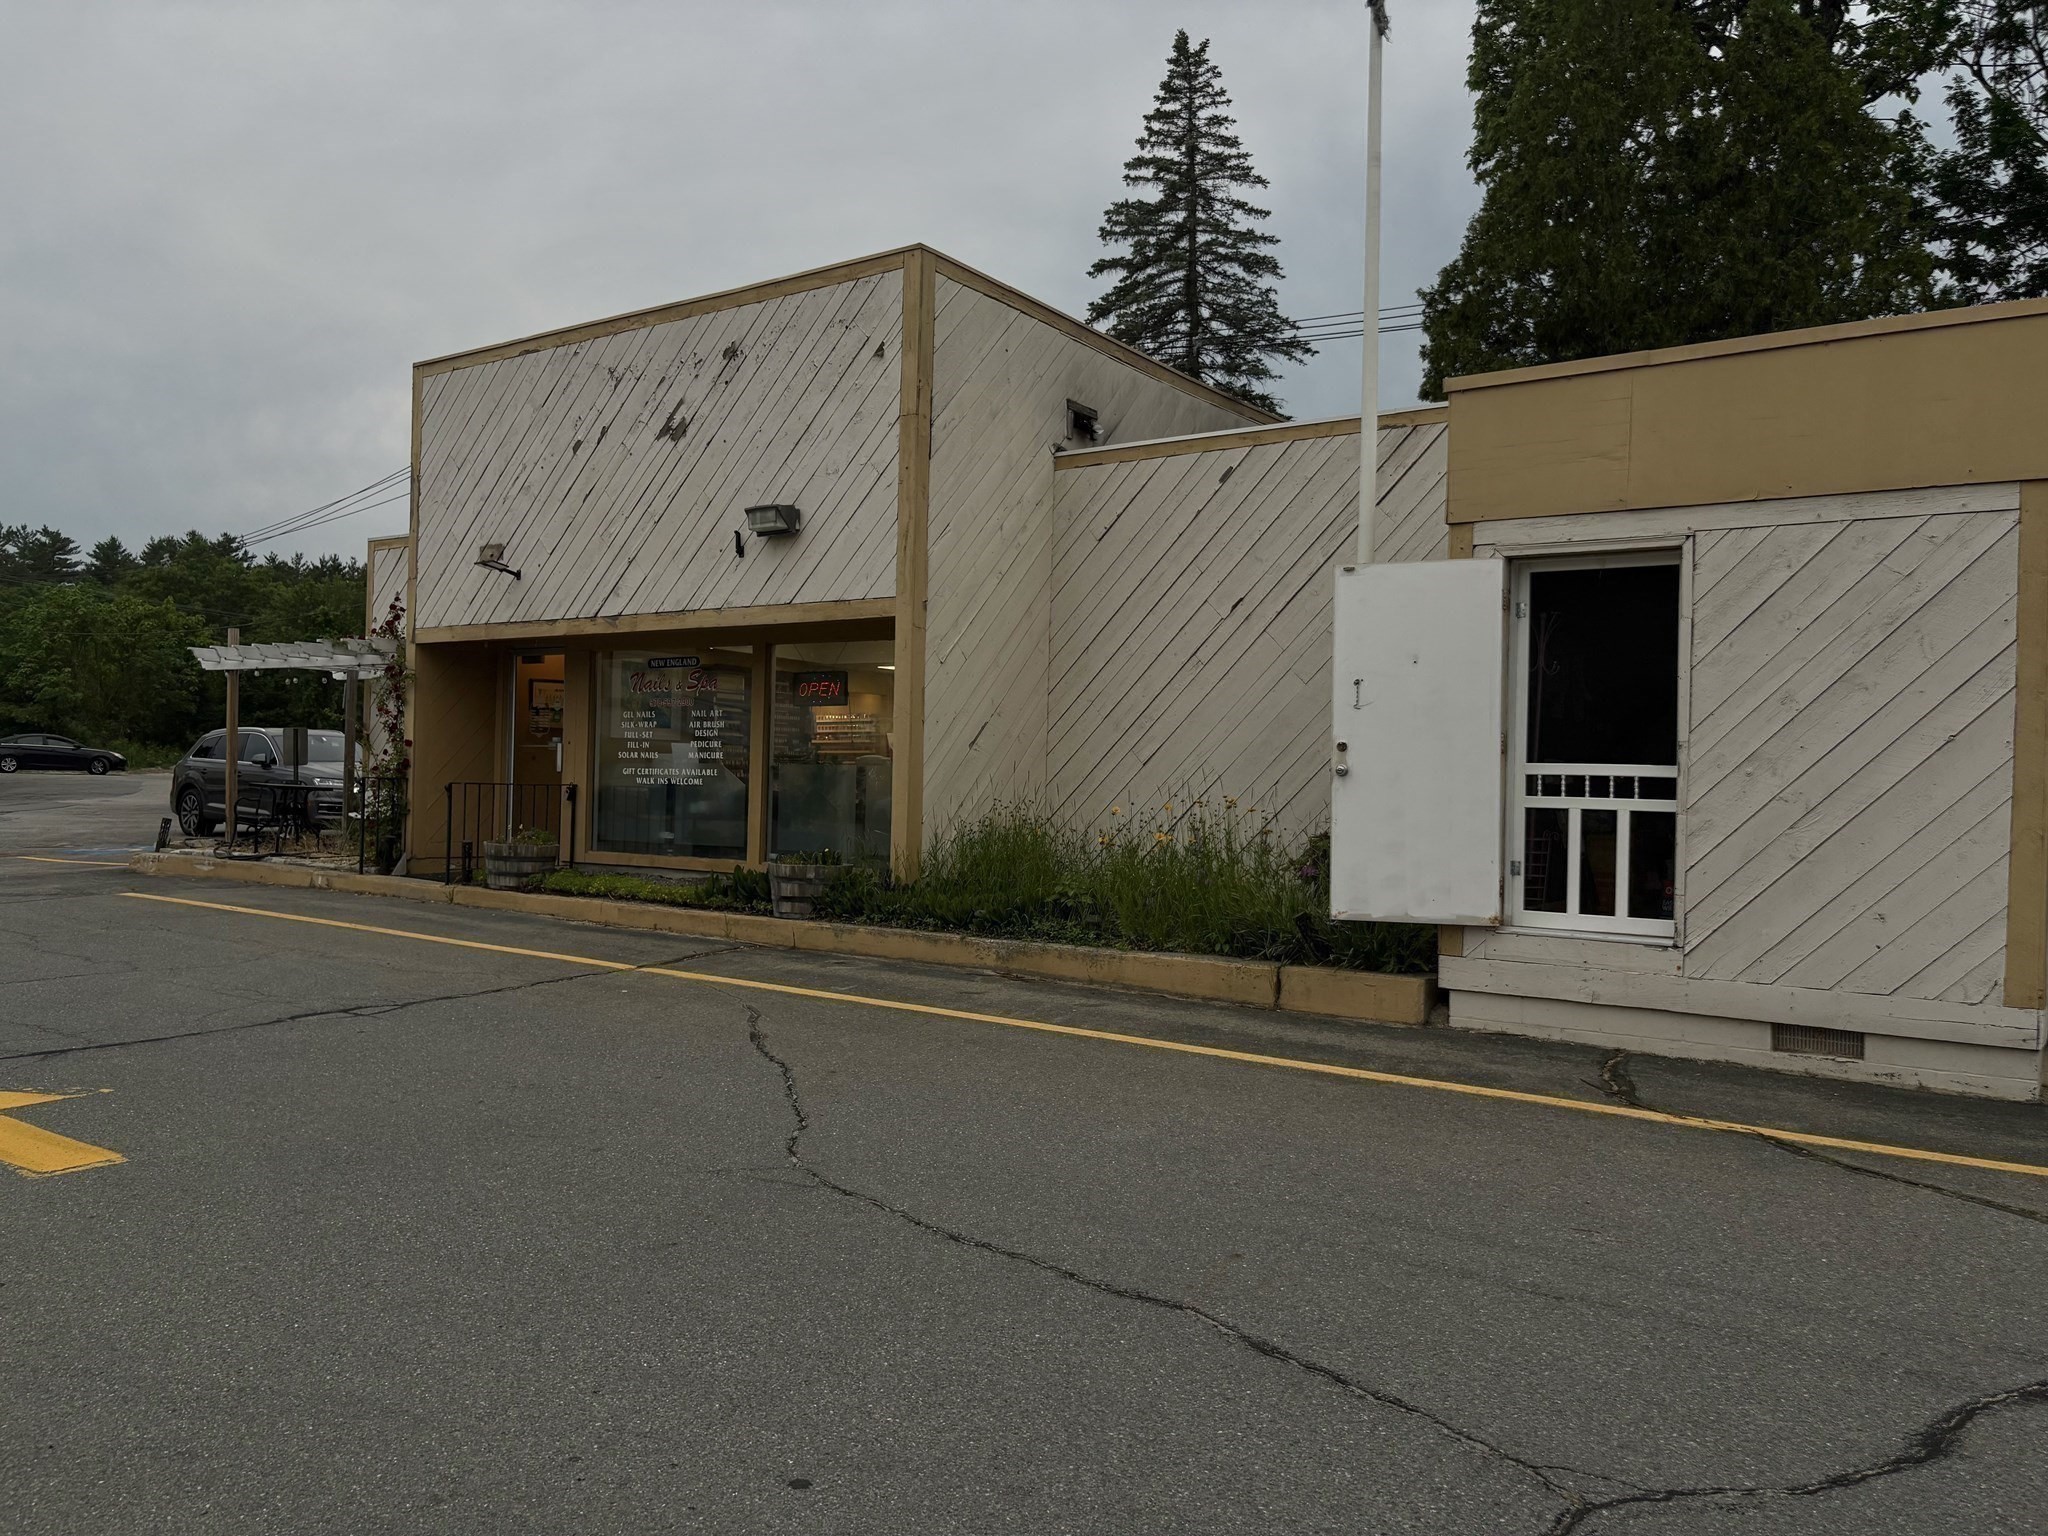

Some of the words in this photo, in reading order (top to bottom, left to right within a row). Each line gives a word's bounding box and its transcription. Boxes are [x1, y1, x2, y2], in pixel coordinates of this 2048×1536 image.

[651, 659, 666, 667] NEW
[667, 658, 697, 666] ENGLAND
[630, 672, 671, 694] Nails
[675, 682, 682, 691] &
[685, 669, 719, 696] Spa
[799, 682, 840, 697] OPEN
[681, 768, 717, 776] AVAILABLE
